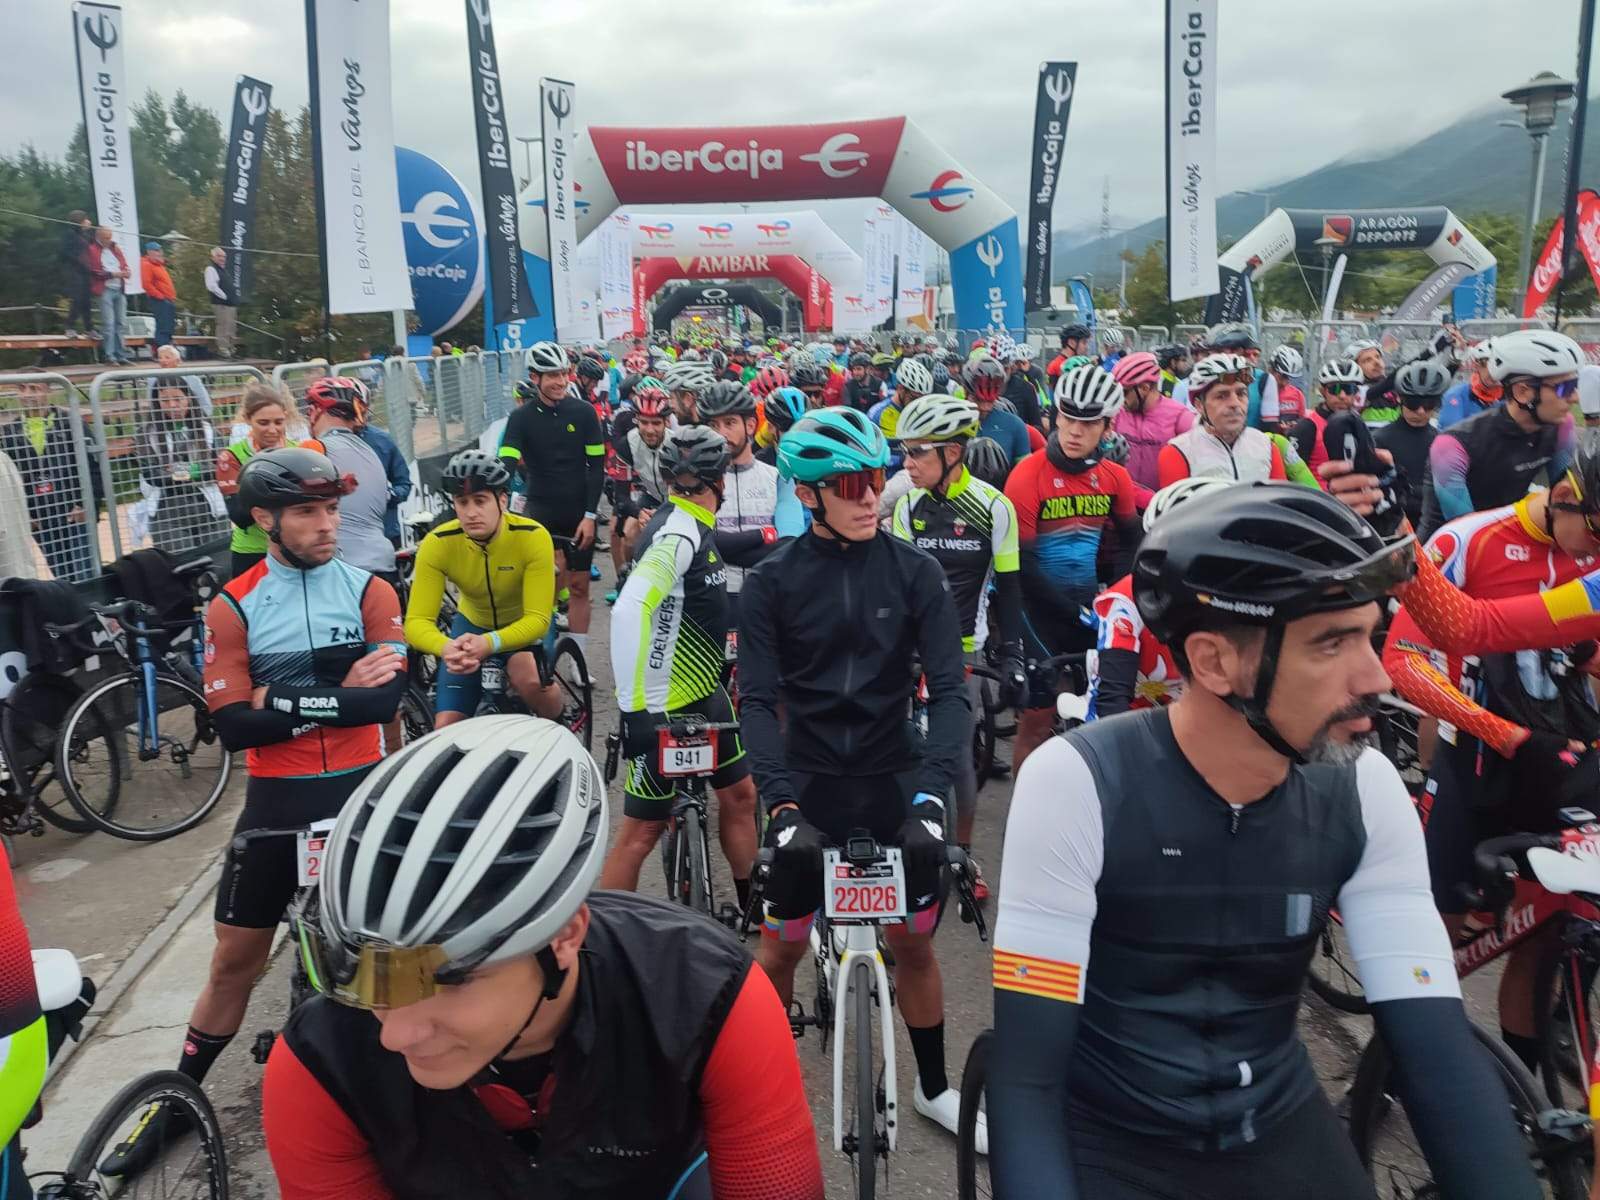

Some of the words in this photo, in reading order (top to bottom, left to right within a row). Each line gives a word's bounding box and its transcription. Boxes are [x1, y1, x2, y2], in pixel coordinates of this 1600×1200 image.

[1181, 12, 1207, 137] iberCaja
[93, 72, 118, 169] iberCaja
[478, 50, 510, 169] iberCaja
[233, 129, 258, 205] iberCaja
[351, 164, 363, 200] DEL
[551, 138, 571, 221] iberCaja
[625, 140, 784, 180] iberCaja
[1036, 120, 1064, 204] iberCaja
[352, 203, 371, 271] BANCO
[697, 254, 771, 273] AMBAR
[1356, 229, 1418, 244] DEPORTE
[916, 537, 982, 552] EDELWEISS
[649, 595, 677, 670] EDELWEISS
[299, 697, 339, 709] BORA
[675, 750, 702, 767] 941
[834, 886, 897, 913] 22026
